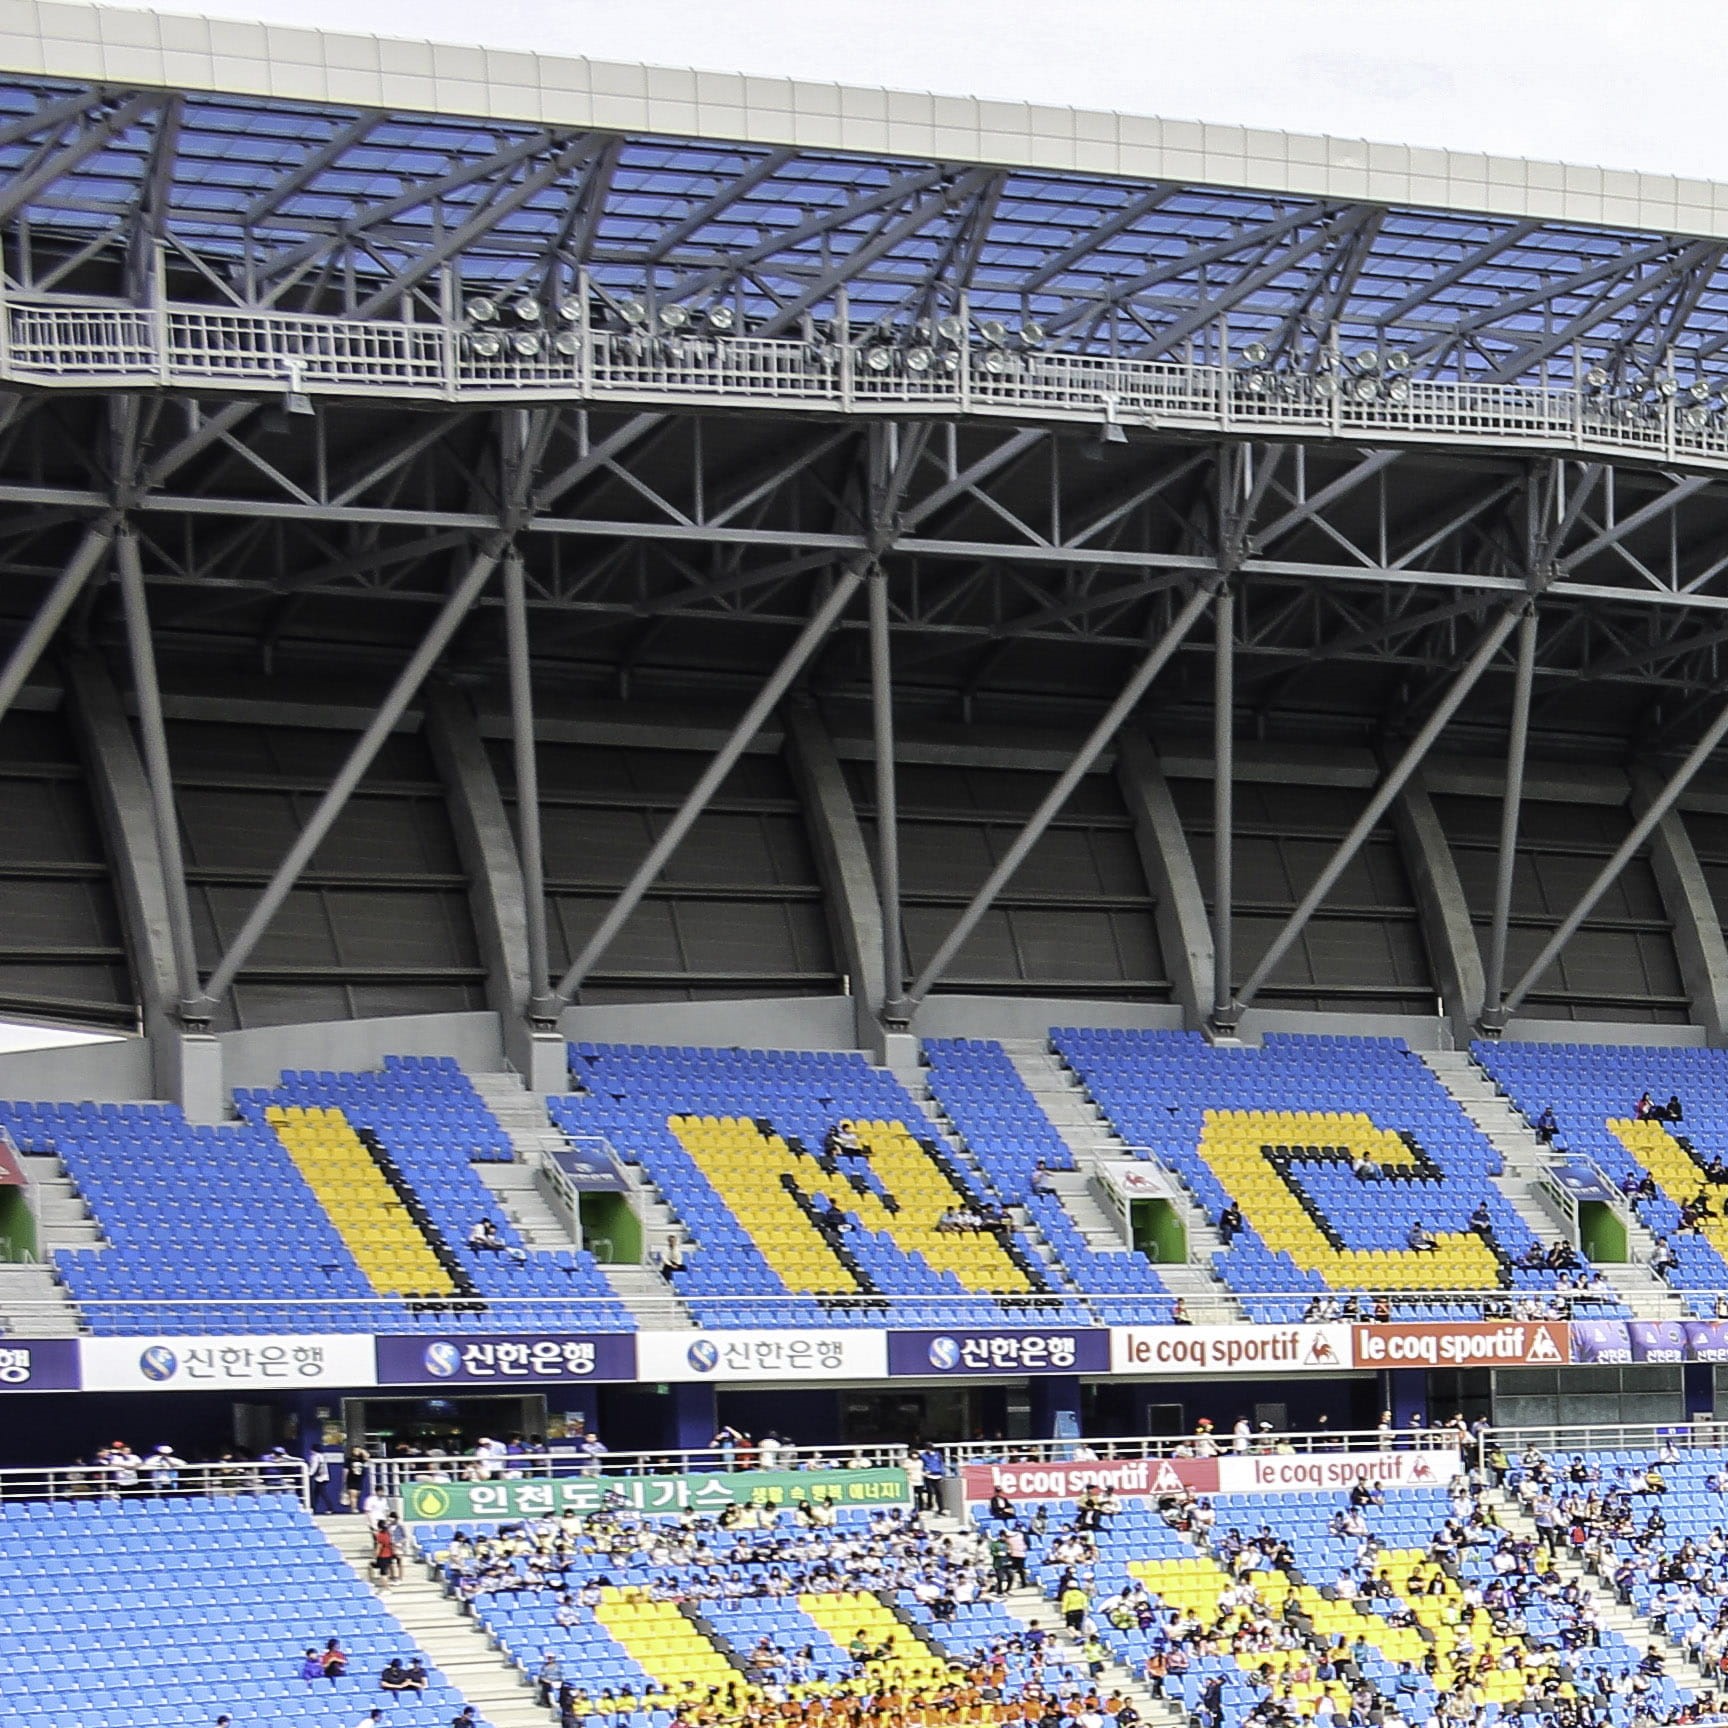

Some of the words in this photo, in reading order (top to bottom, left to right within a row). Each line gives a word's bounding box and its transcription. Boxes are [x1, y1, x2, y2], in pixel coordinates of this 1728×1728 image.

[183, 1346, 325, 1379] 신한은행
[461, 1341, 596, 1377] 신한은행
[723, 1339, 845, 1370] 신한은행
[960, 1336, 1076, 1369] 신한은행
[1127, 1333, 1152, 1363] le
[1156, 1340, 1206, 1367] coq
[1211, 1331, 1300, 1367] sportif
[1360, 1329, 1387, 1360] le
[1388, 1335, 1437, 1365] coq
[1438, 1327, 1525, 1363] sportif
[992, 1466, 1017, 1494] le
[1019, 1471, 1066, 1496] coq
[1069, 1463, 1149, 1492] sportif
[1256, 1460, 1275, 1484] le
[1280, 1464, 1323, 1486] coq
[1328, 1457, 1403, 1486] sportif
[468, 1480, 735, 1515] 인천도시가스
